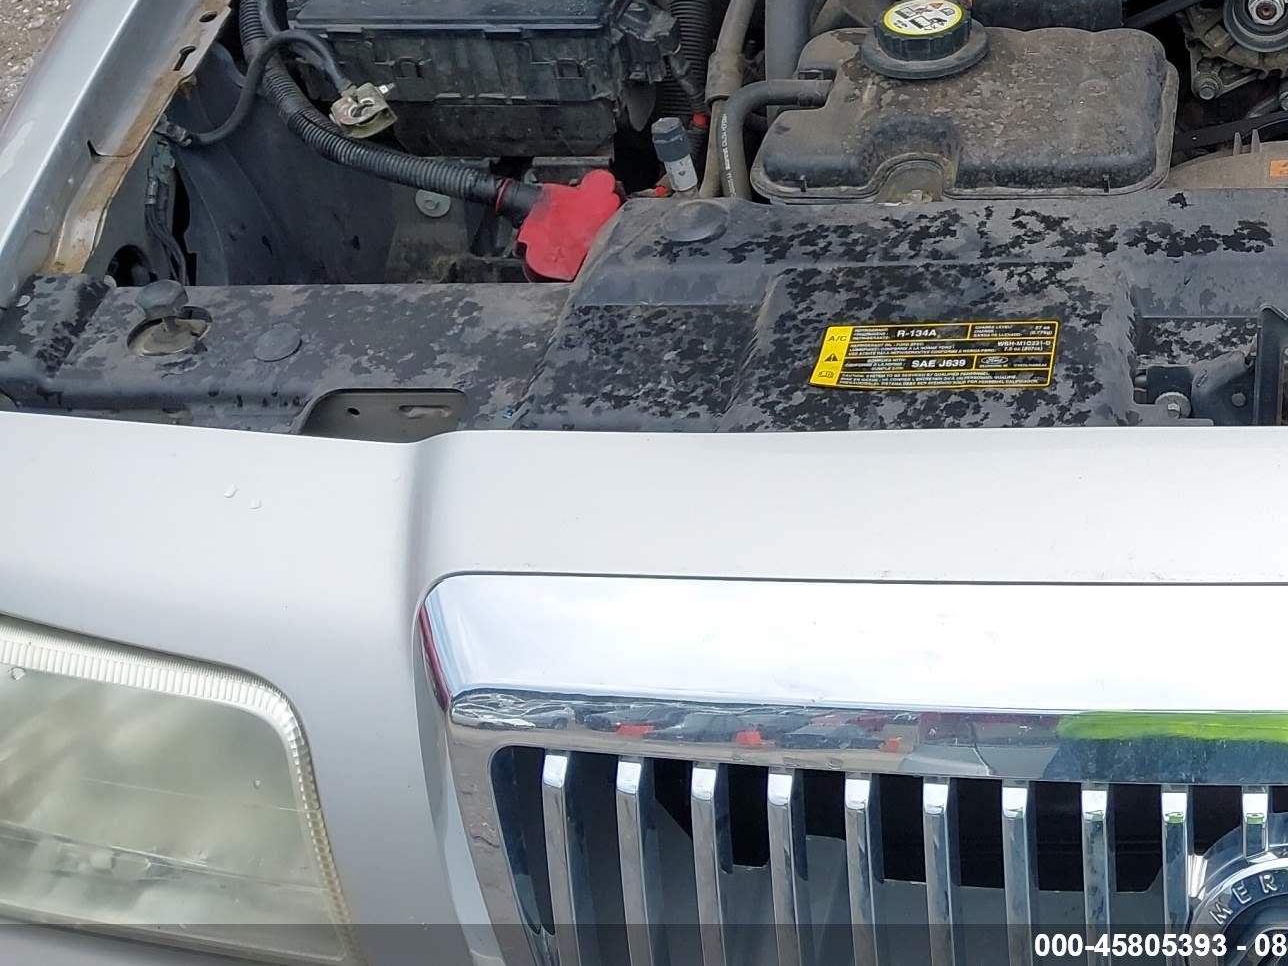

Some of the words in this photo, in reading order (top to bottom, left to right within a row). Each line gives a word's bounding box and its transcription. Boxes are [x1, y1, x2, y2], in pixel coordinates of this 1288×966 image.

[896, 329, 937, 338] R-134A
[911, 359, 936, 368] SAE
[938, 359, 966, 367] J639
